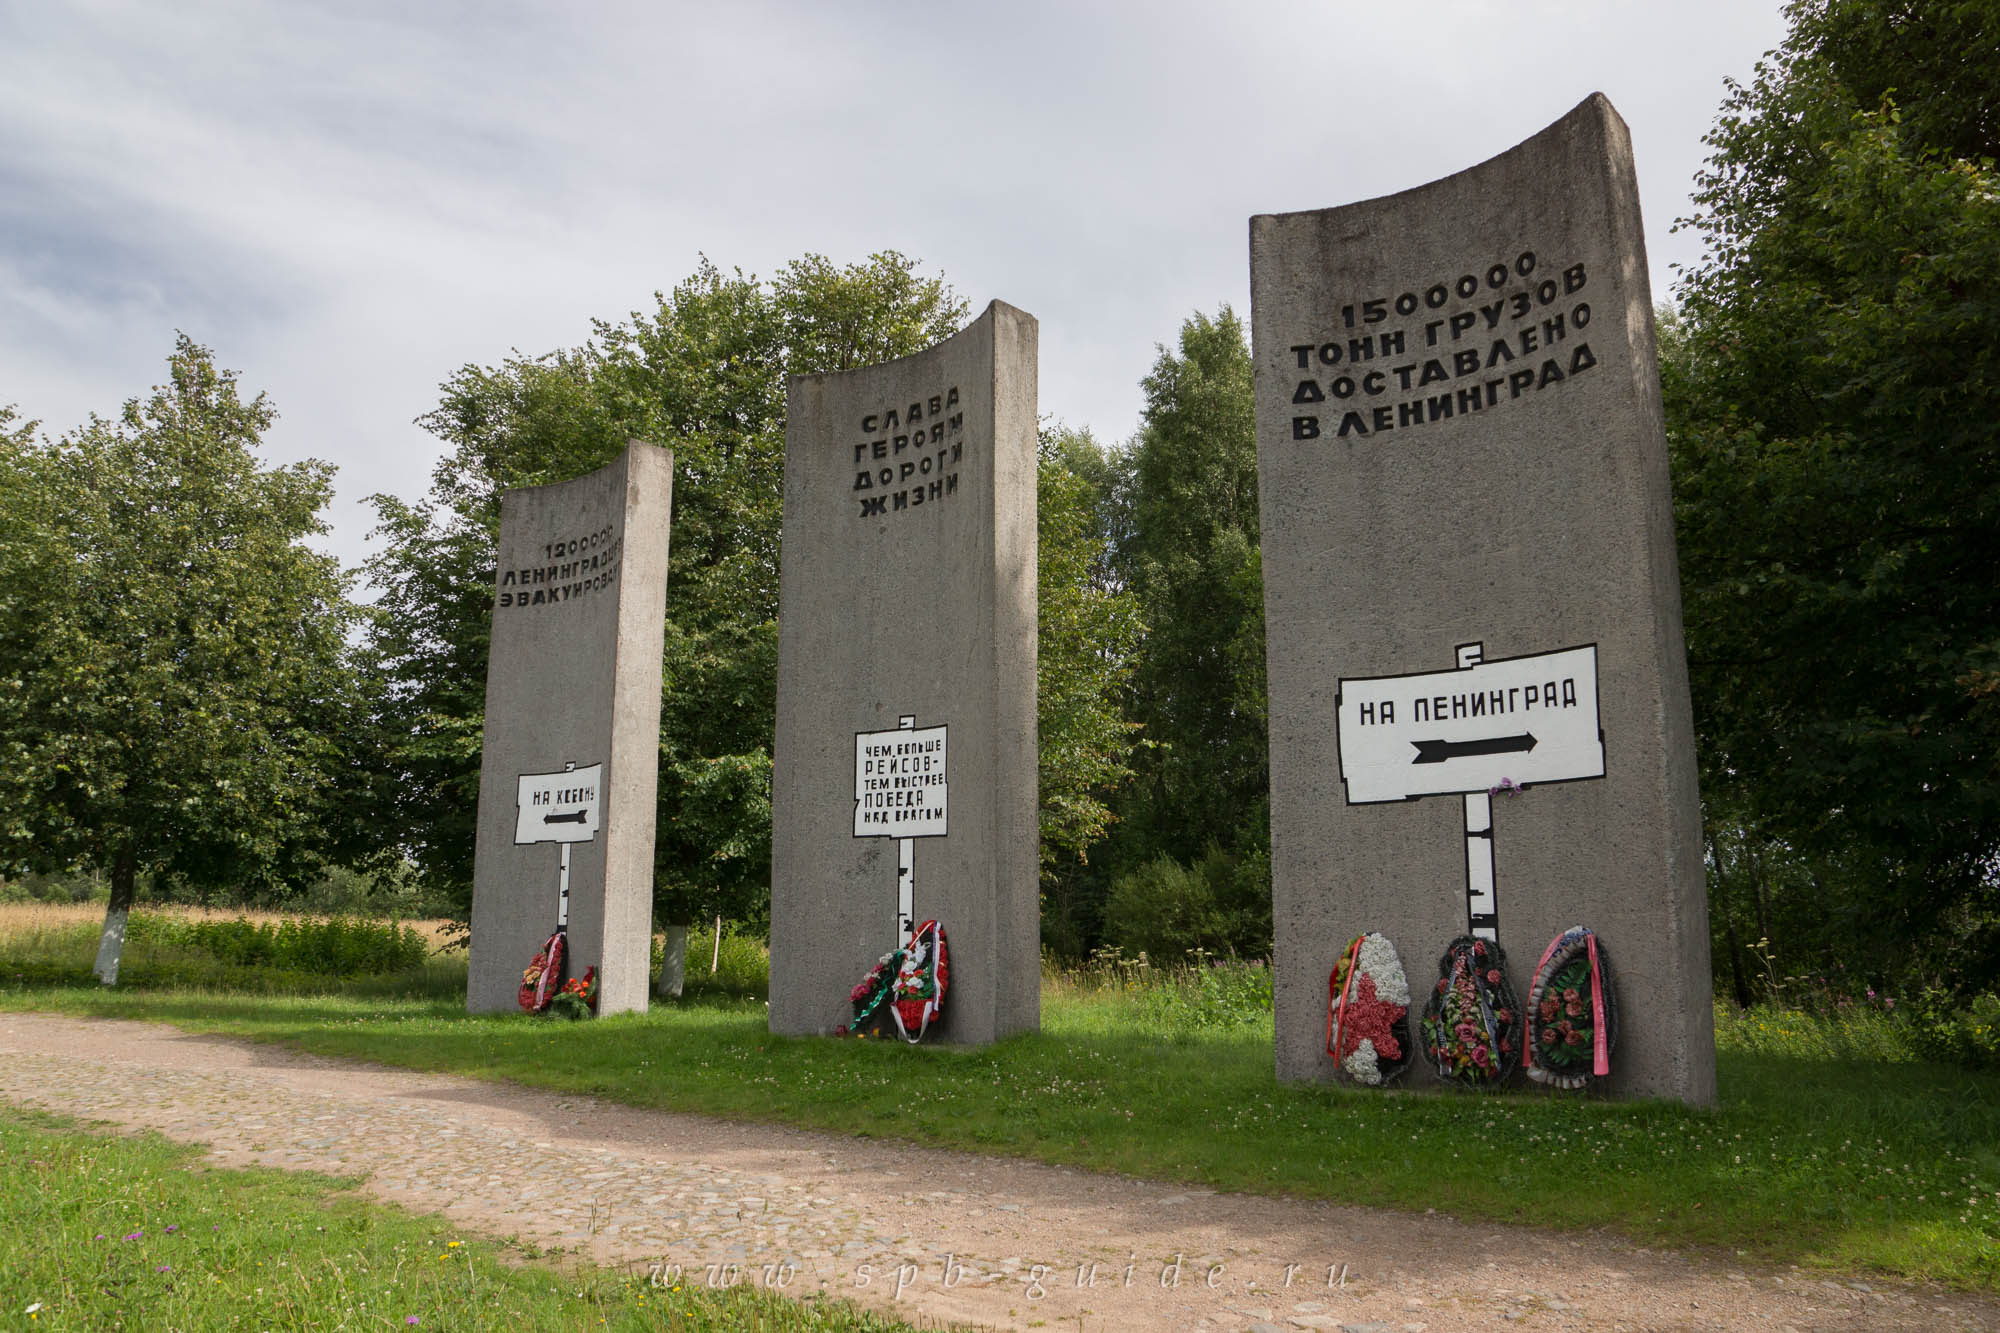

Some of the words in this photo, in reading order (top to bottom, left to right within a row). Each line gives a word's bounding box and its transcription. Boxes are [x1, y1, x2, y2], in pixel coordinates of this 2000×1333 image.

[1342, 251, 1536, 328] 1500000
[1290, 330, 1405, 369] ТОНН
[1425, 262, 1587, 346] ГРУЗОВ
[1291, 302, 1591, 404] ДОСТАВЛЕНО
[862, 386, 959, 433] СЛАВА
[1292, 416, 1320, 440] В
[1337, 343, 1597, 437] ЛЕНИНГРАД
[854, 412, 963, 463] ГЕРОЯМ
[853, 442, 962, 490] ДОРОГИ
[860, 473, 958, 518] ЖИЗНИ
[500, 560, 620, 607] ЭВАКУИРОВАН
[1360, 700, 1395, 725] НА
[1414, 678, 1577, 722] ЛЕНИНГРАД
[866, 745, 892, 757] ЧЕМ
[898, 740, 941, 755] БОЛЬШЕ
[533, 791, 550, 805] НА
[865, 778, 889, 790] ТЕМ
[895, 774, 943, 788] БЫСТРЕЕ
[865, 790, 923, 808] ПОБЕДА
[865, 811, 888, 824] НАД
[896, 808, 942, 822] ВРАГОМ
